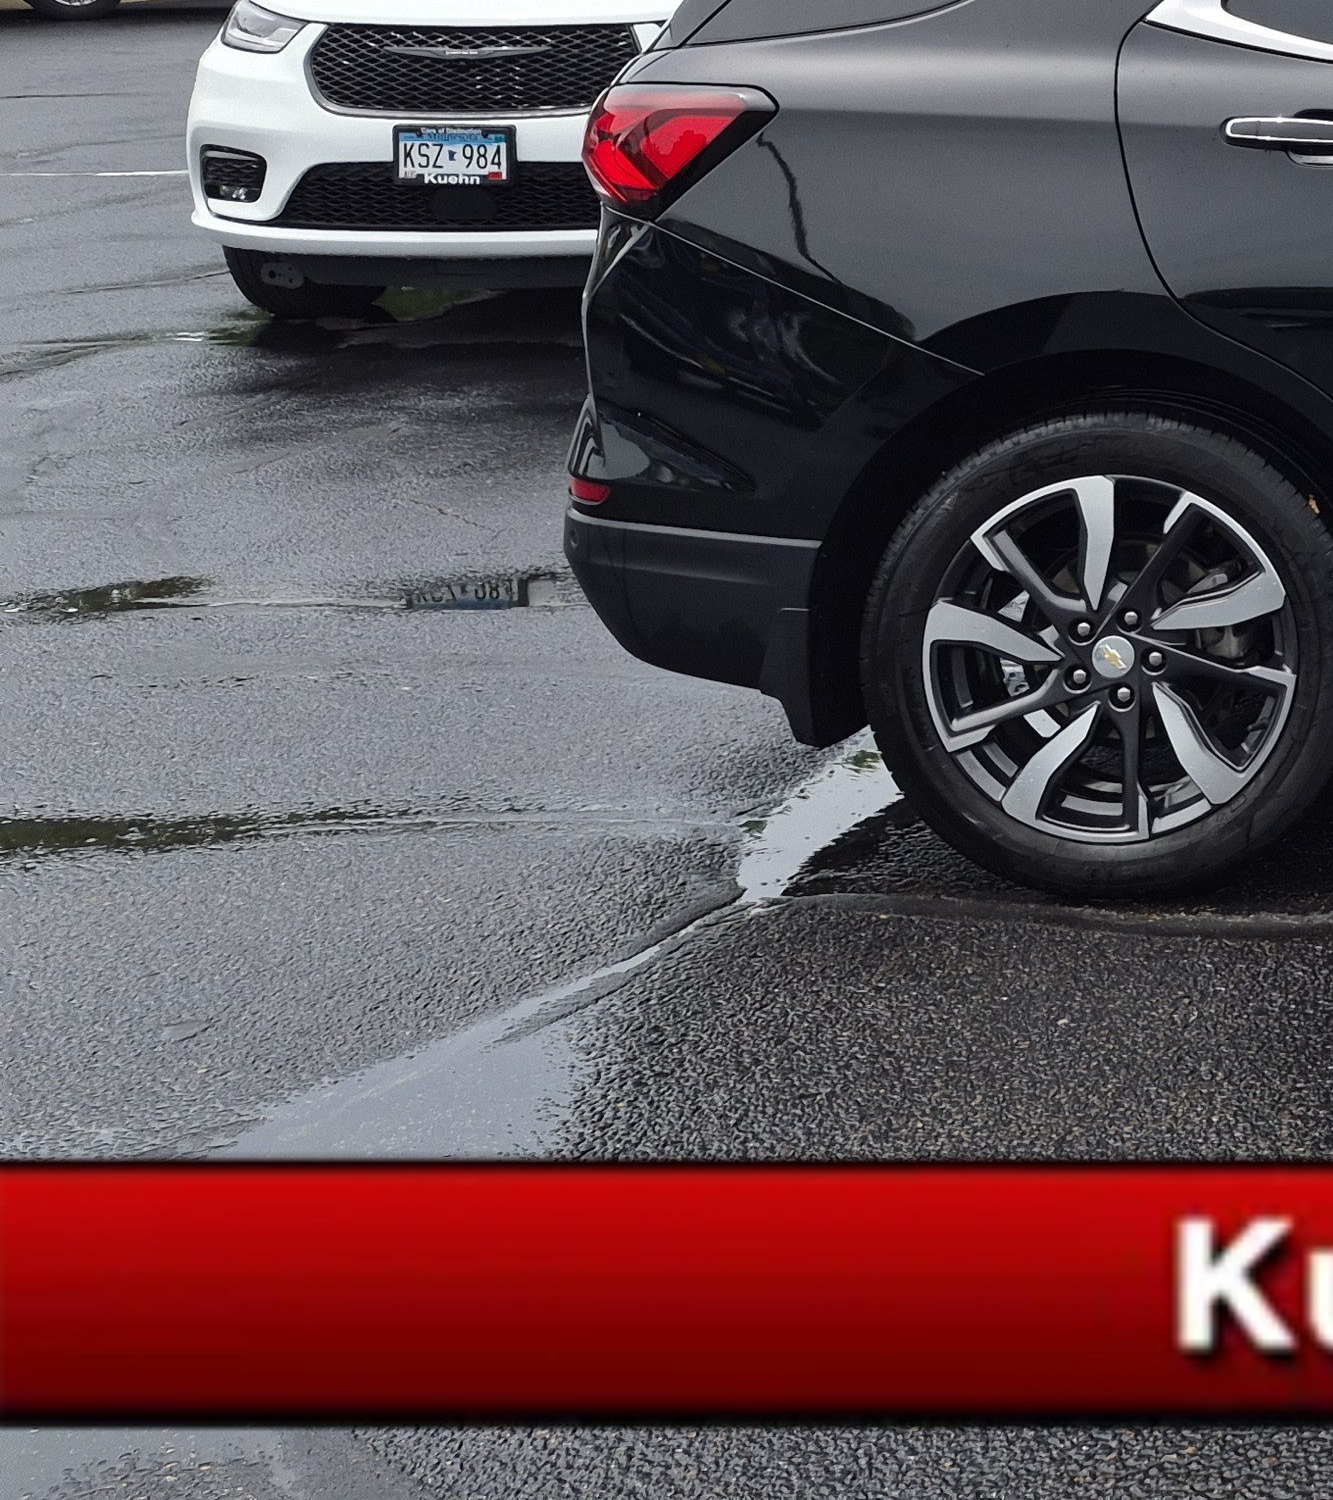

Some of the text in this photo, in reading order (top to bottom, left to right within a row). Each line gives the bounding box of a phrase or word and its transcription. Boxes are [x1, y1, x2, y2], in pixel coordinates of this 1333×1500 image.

[403, 142, 502, 170] KSZ 984
[424, 173, 481, 185] Kuehn
